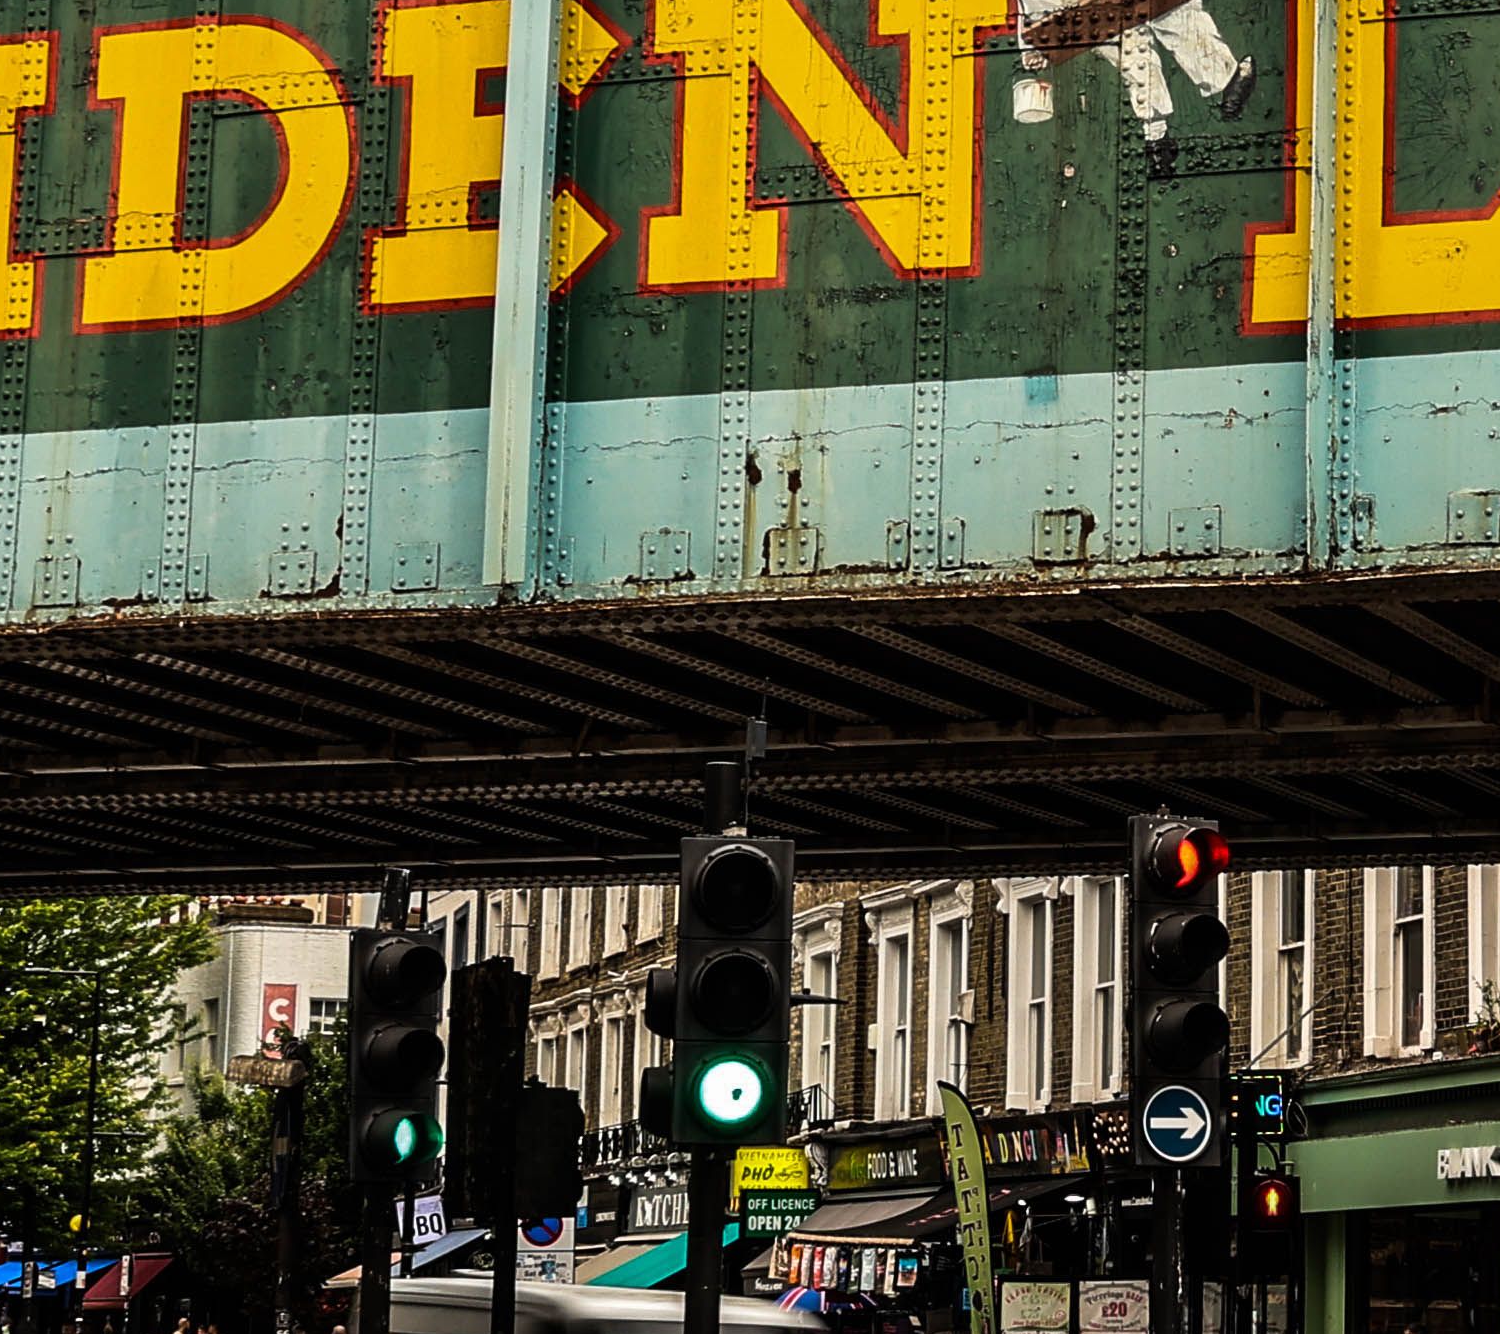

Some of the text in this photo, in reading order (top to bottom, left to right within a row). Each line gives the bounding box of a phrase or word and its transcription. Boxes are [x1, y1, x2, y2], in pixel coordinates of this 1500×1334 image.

[867, 1152, 888, 1180] FOOD
[888, 1150, 896, 1178] &
[896, 1148, 918, 1177] WINE
[748, 1198, 816, 1210] OFF LICENCE
[414, 1212, 443, 1237] BQ
[748, 1215, 782, 1231] OPEN
[1101, 1301, 1128, 1317] £20
